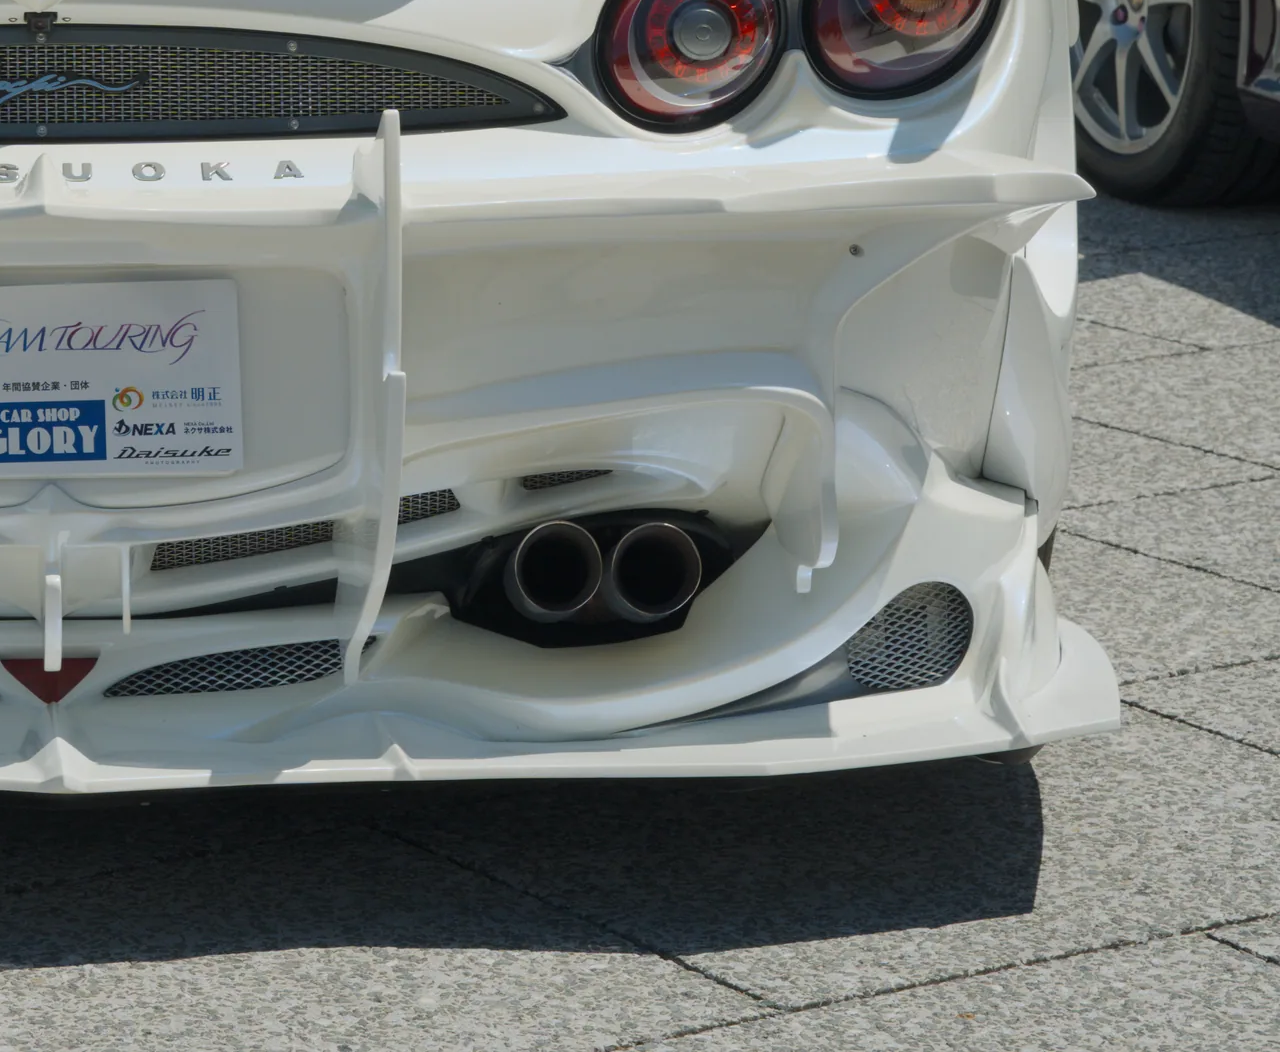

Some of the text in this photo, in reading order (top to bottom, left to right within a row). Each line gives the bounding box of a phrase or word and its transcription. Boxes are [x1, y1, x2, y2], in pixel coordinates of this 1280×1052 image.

[49, 310, 206, 366] TOURING
[2, 381, 90, 393] 年間協賛企業・団体
[0, 408, 81, 423] CAR SHOP
[132, 423, 176, 436] NEXA
[113, 446, 232, 459] Daisuke
